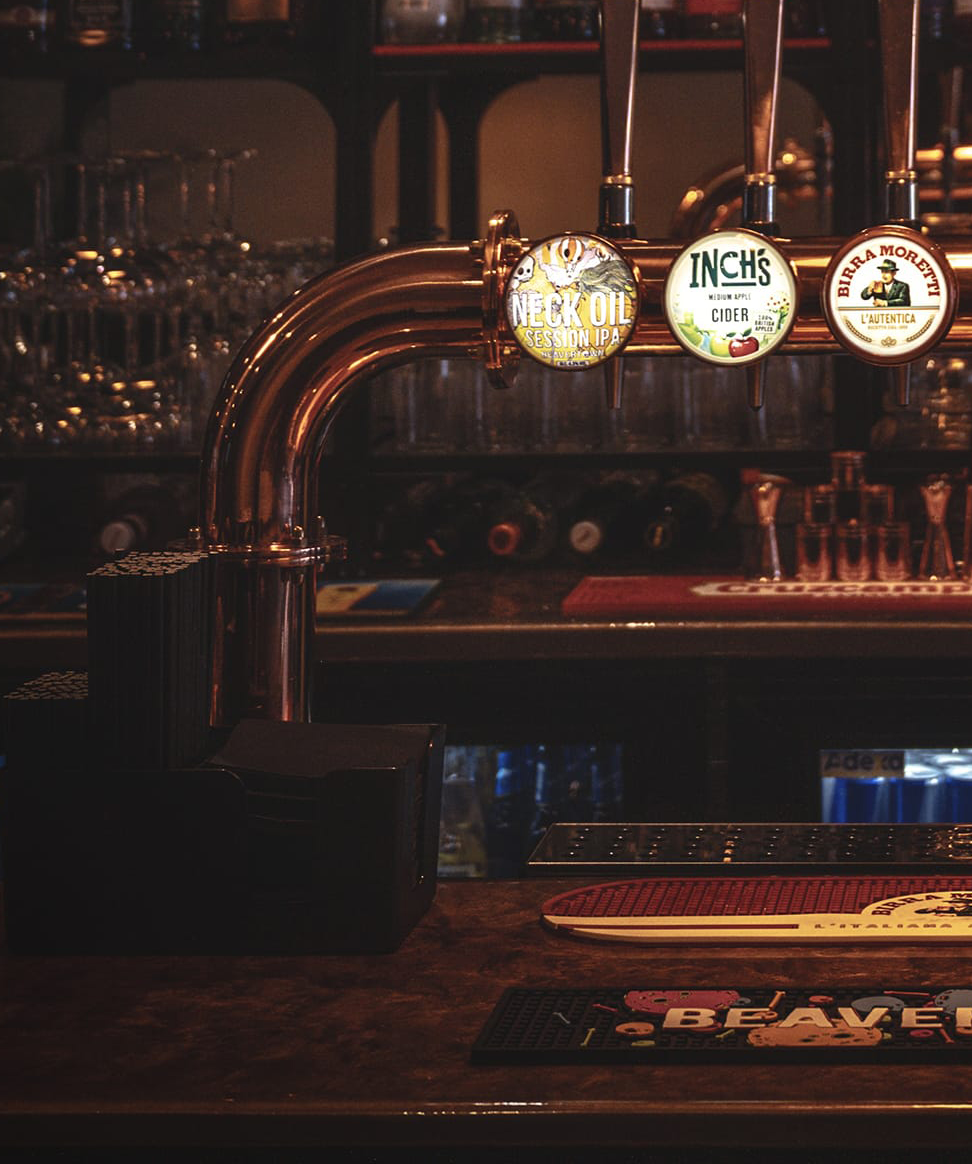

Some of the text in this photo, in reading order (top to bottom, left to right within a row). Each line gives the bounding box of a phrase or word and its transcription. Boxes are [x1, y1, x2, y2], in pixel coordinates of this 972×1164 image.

[689, 248, 771, 288] INCH'S
[838, 244, 941, 298] BIRRA MORETTI
[512, 291, 631, 328] NECK OIL
[711, 307, 749, 323] CIDER
[861, 313, 916, 324] L'AUTENTICA
[525, 327, 620, 349] SESSION IPA
[871, 894, 943, 916] BIRRA
